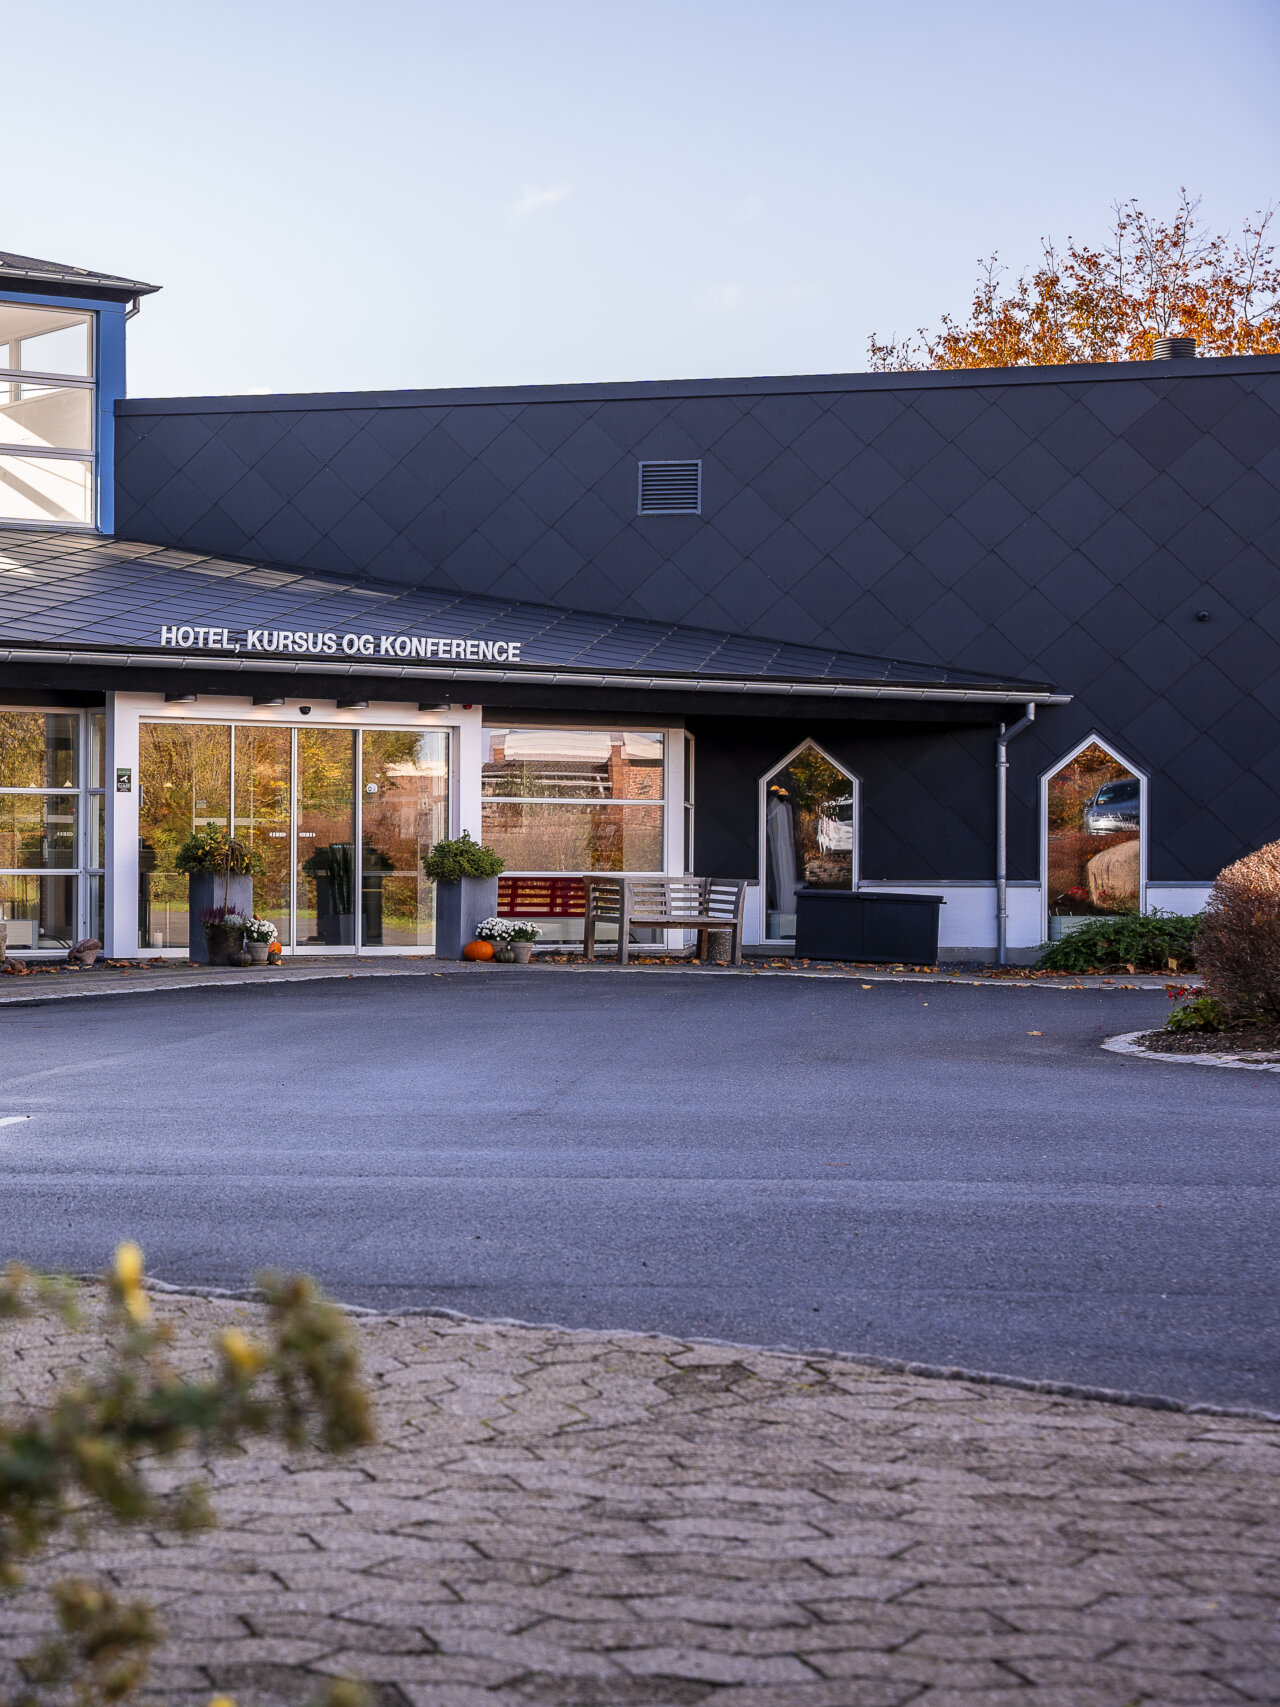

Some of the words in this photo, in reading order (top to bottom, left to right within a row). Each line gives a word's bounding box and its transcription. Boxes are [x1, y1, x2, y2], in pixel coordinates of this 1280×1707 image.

[160, 626, 241, 652] HOTEL,
[247, 629, 337, 653] KURSUS
[342, 633, 374, 655] OG
[380, 635, 521, 662] KONFERENCE
